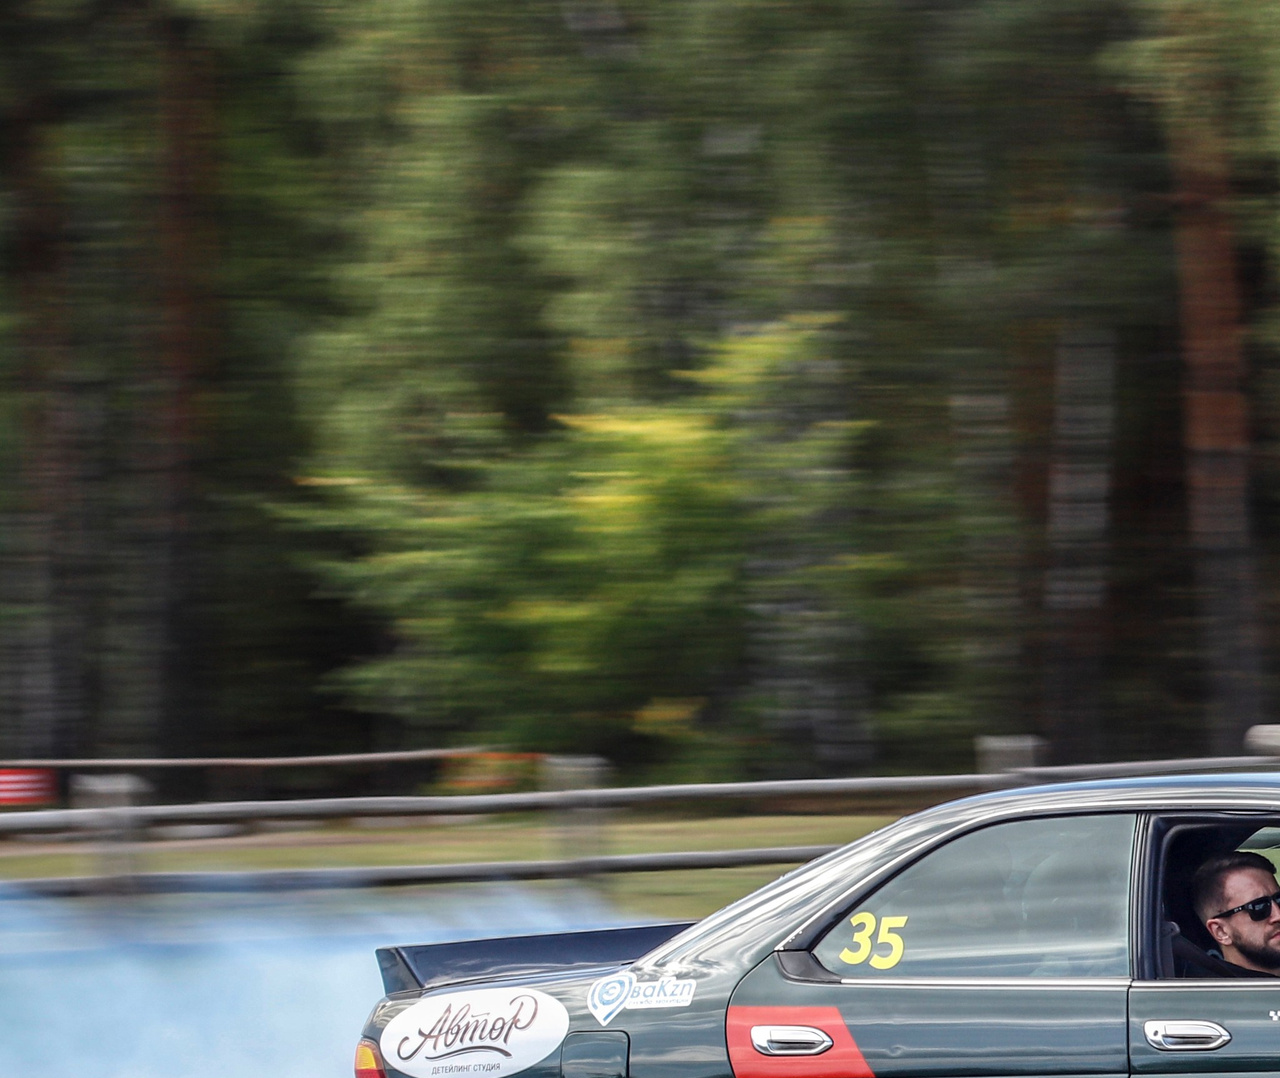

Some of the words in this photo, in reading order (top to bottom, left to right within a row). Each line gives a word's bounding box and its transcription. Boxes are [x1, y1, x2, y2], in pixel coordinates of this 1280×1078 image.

[838, 911, 908, 970] 35
[431, 1064, 472, 1075] ДЕТЕЙЛИНГ
[473, 1063, 501, 1072] СТУДИЯ
